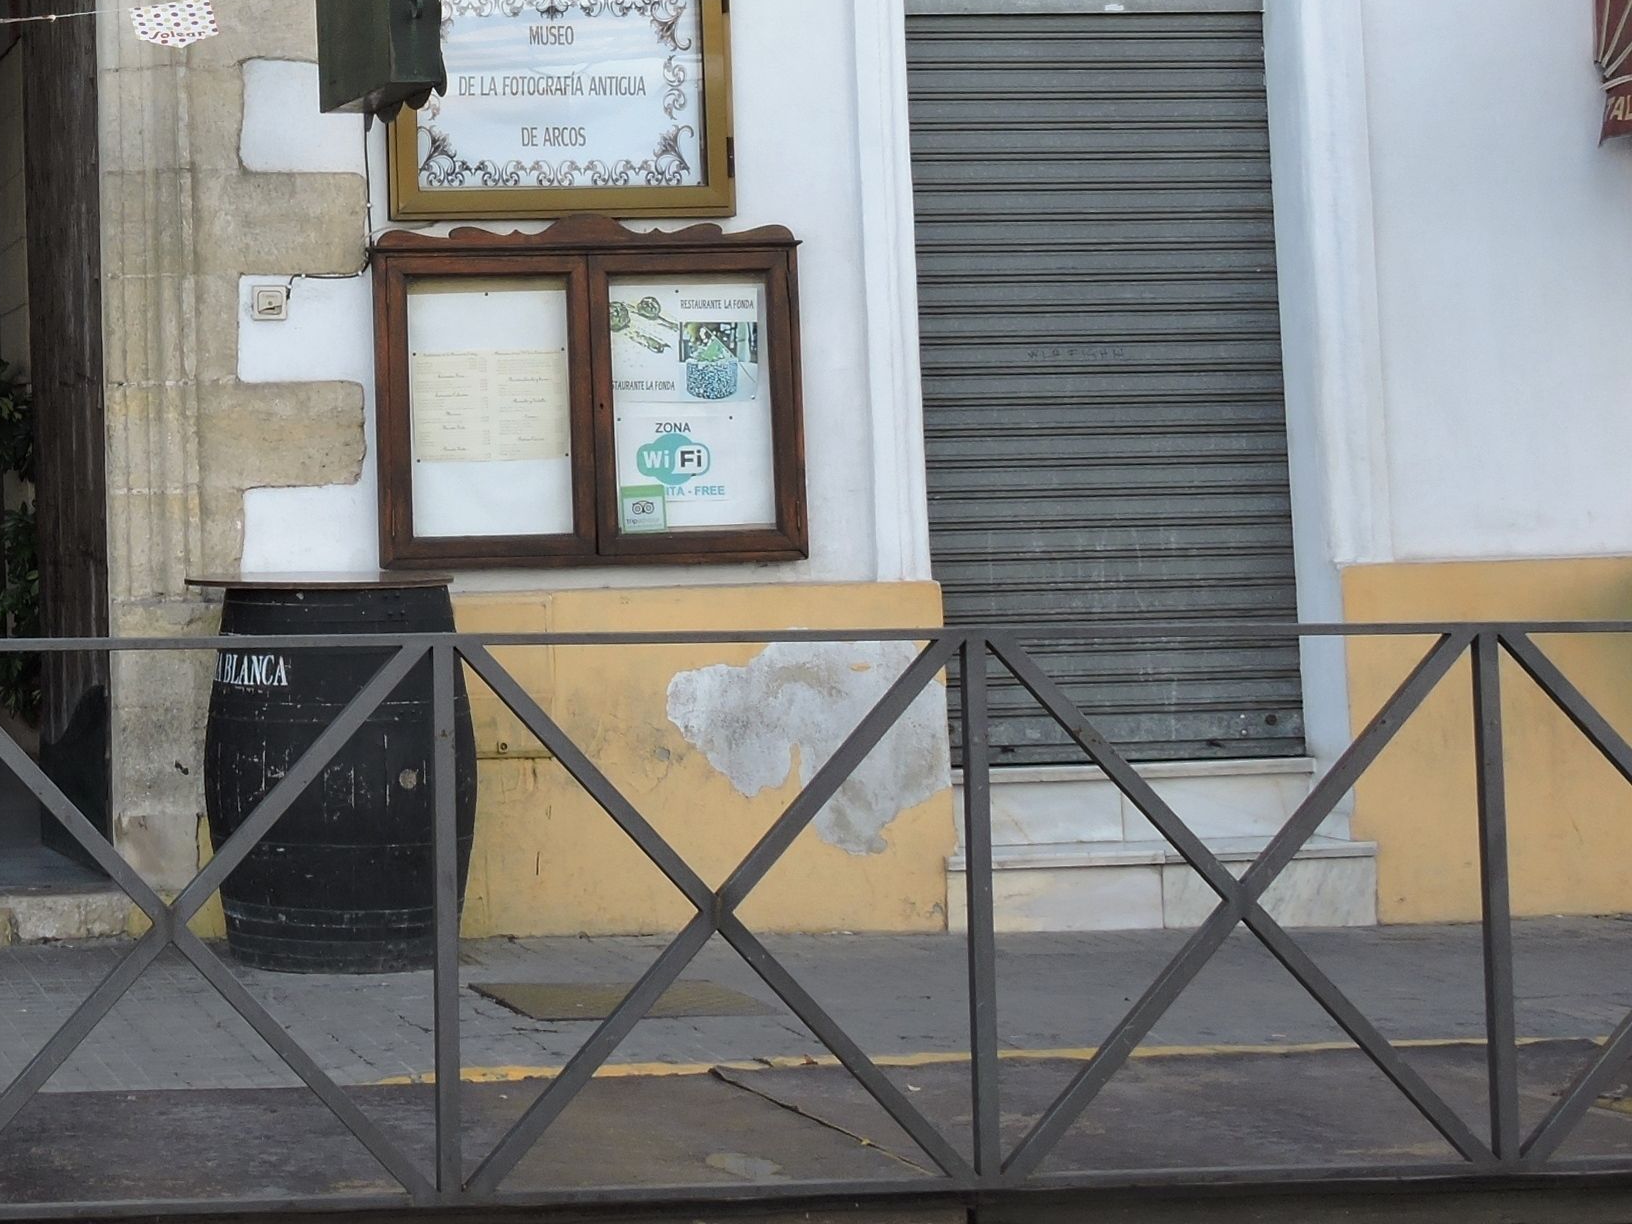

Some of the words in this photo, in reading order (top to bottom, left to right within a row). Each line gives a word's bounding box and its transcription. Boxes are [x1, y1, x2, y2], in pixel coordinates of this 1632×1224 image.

[528, 25, 574, 45] MUSEO
[458, 76, 478, 96] DE
[480, 76, 498, 96] LA
[502, 71, 583, 97] FOTOGRAFÍA
[588, 76, 646, 97] ANTIGUA
[521, 127, 539, 147] DE
[543, 127, 586, 147] ARCOS
[680, 299, 722, 309] RESTAURANTE
[724, 299, 732, 309] LA
[733, 299, 754, 309] FONDA
[646, 380, 653, 391] LA
[654, 380, 676, 391] FONDA
[655, 422, 691, 433] ZONA
[643, 448, 702, 469] WiFi
[694, 485, 726, 495] FREE
[223, 654, 289, 686] BLANCA
